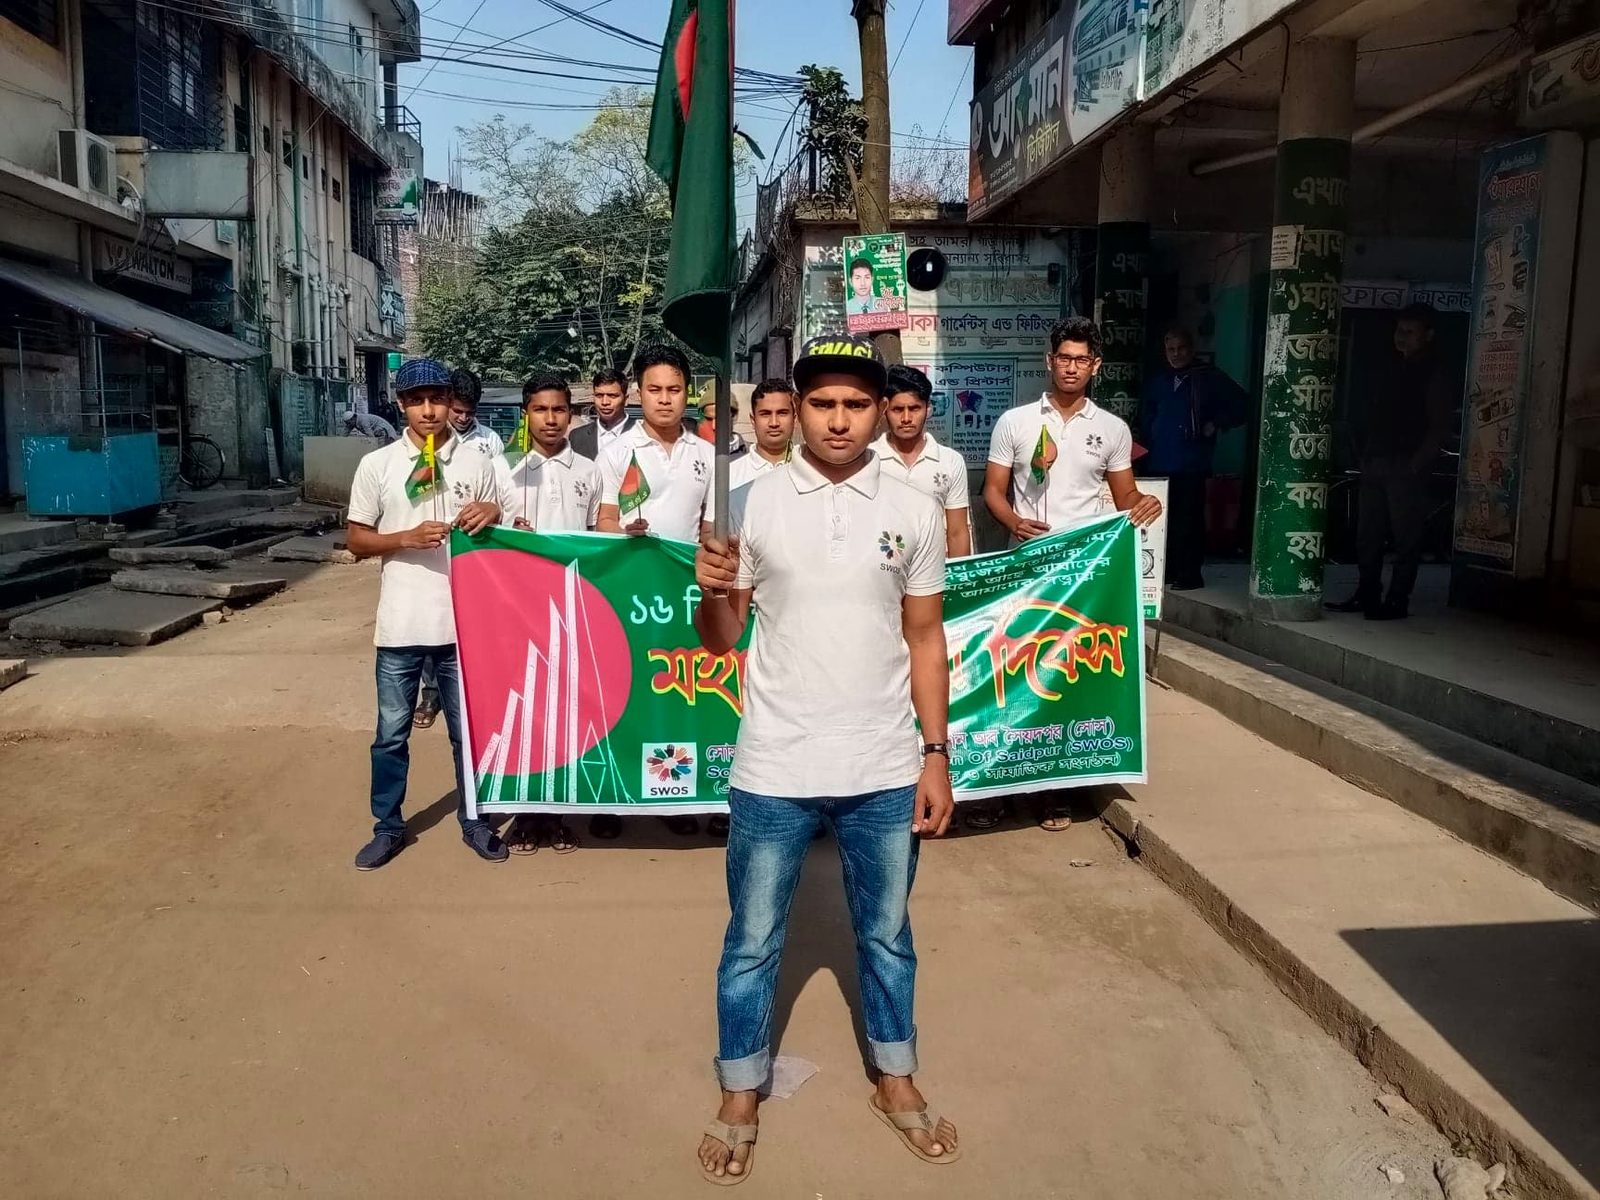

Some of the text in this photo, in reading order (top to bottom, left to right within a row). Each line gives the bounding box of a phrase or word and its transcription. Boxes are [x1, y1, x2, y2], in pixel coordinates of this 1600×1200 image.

[131, 249, 175, 281] WALTON
[908, 314, 939, 332] াকা
[630, 595, 674, 624] ১৬
[647, 646, 748, 718] মহা
[968, 736, 1134, 766] Of Saidpur (SWOS)
[650, 785, 689, 797] SWOS
